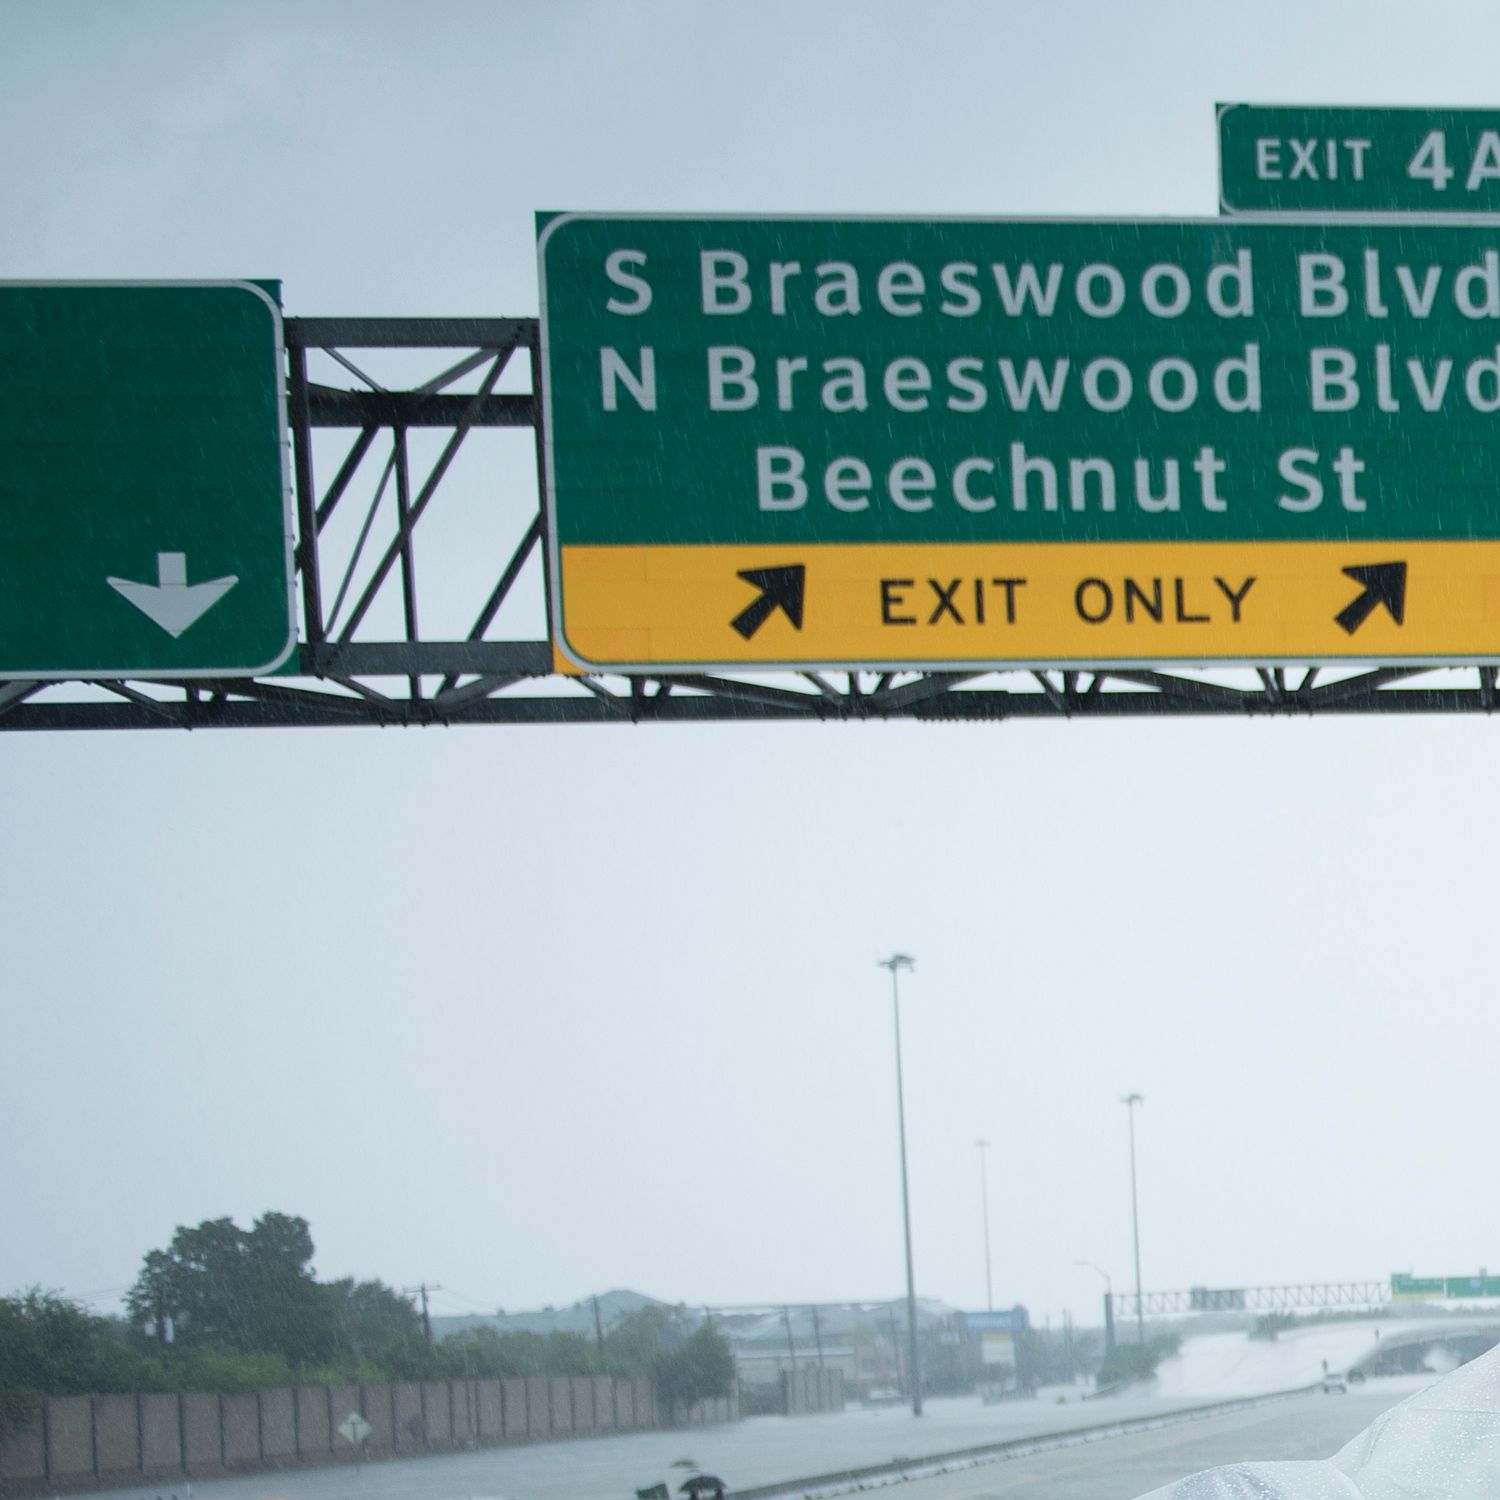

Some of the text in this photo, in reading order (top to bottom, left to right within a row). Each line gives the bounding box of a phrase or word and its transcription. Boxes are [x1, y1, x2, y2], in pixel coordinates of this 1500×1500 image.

[1256, 137, 1372, 180] EXIT
[604, 248, 653, 316] S
[699, 248, 1254, 317] Braeswood
[599, 346, 657, 411] N
[707, 343, 1262, 412] Braeswood
[756, 442, 1367, 512] Beechnut St
[878, 576, 1257, 626] EXIT ONLY
